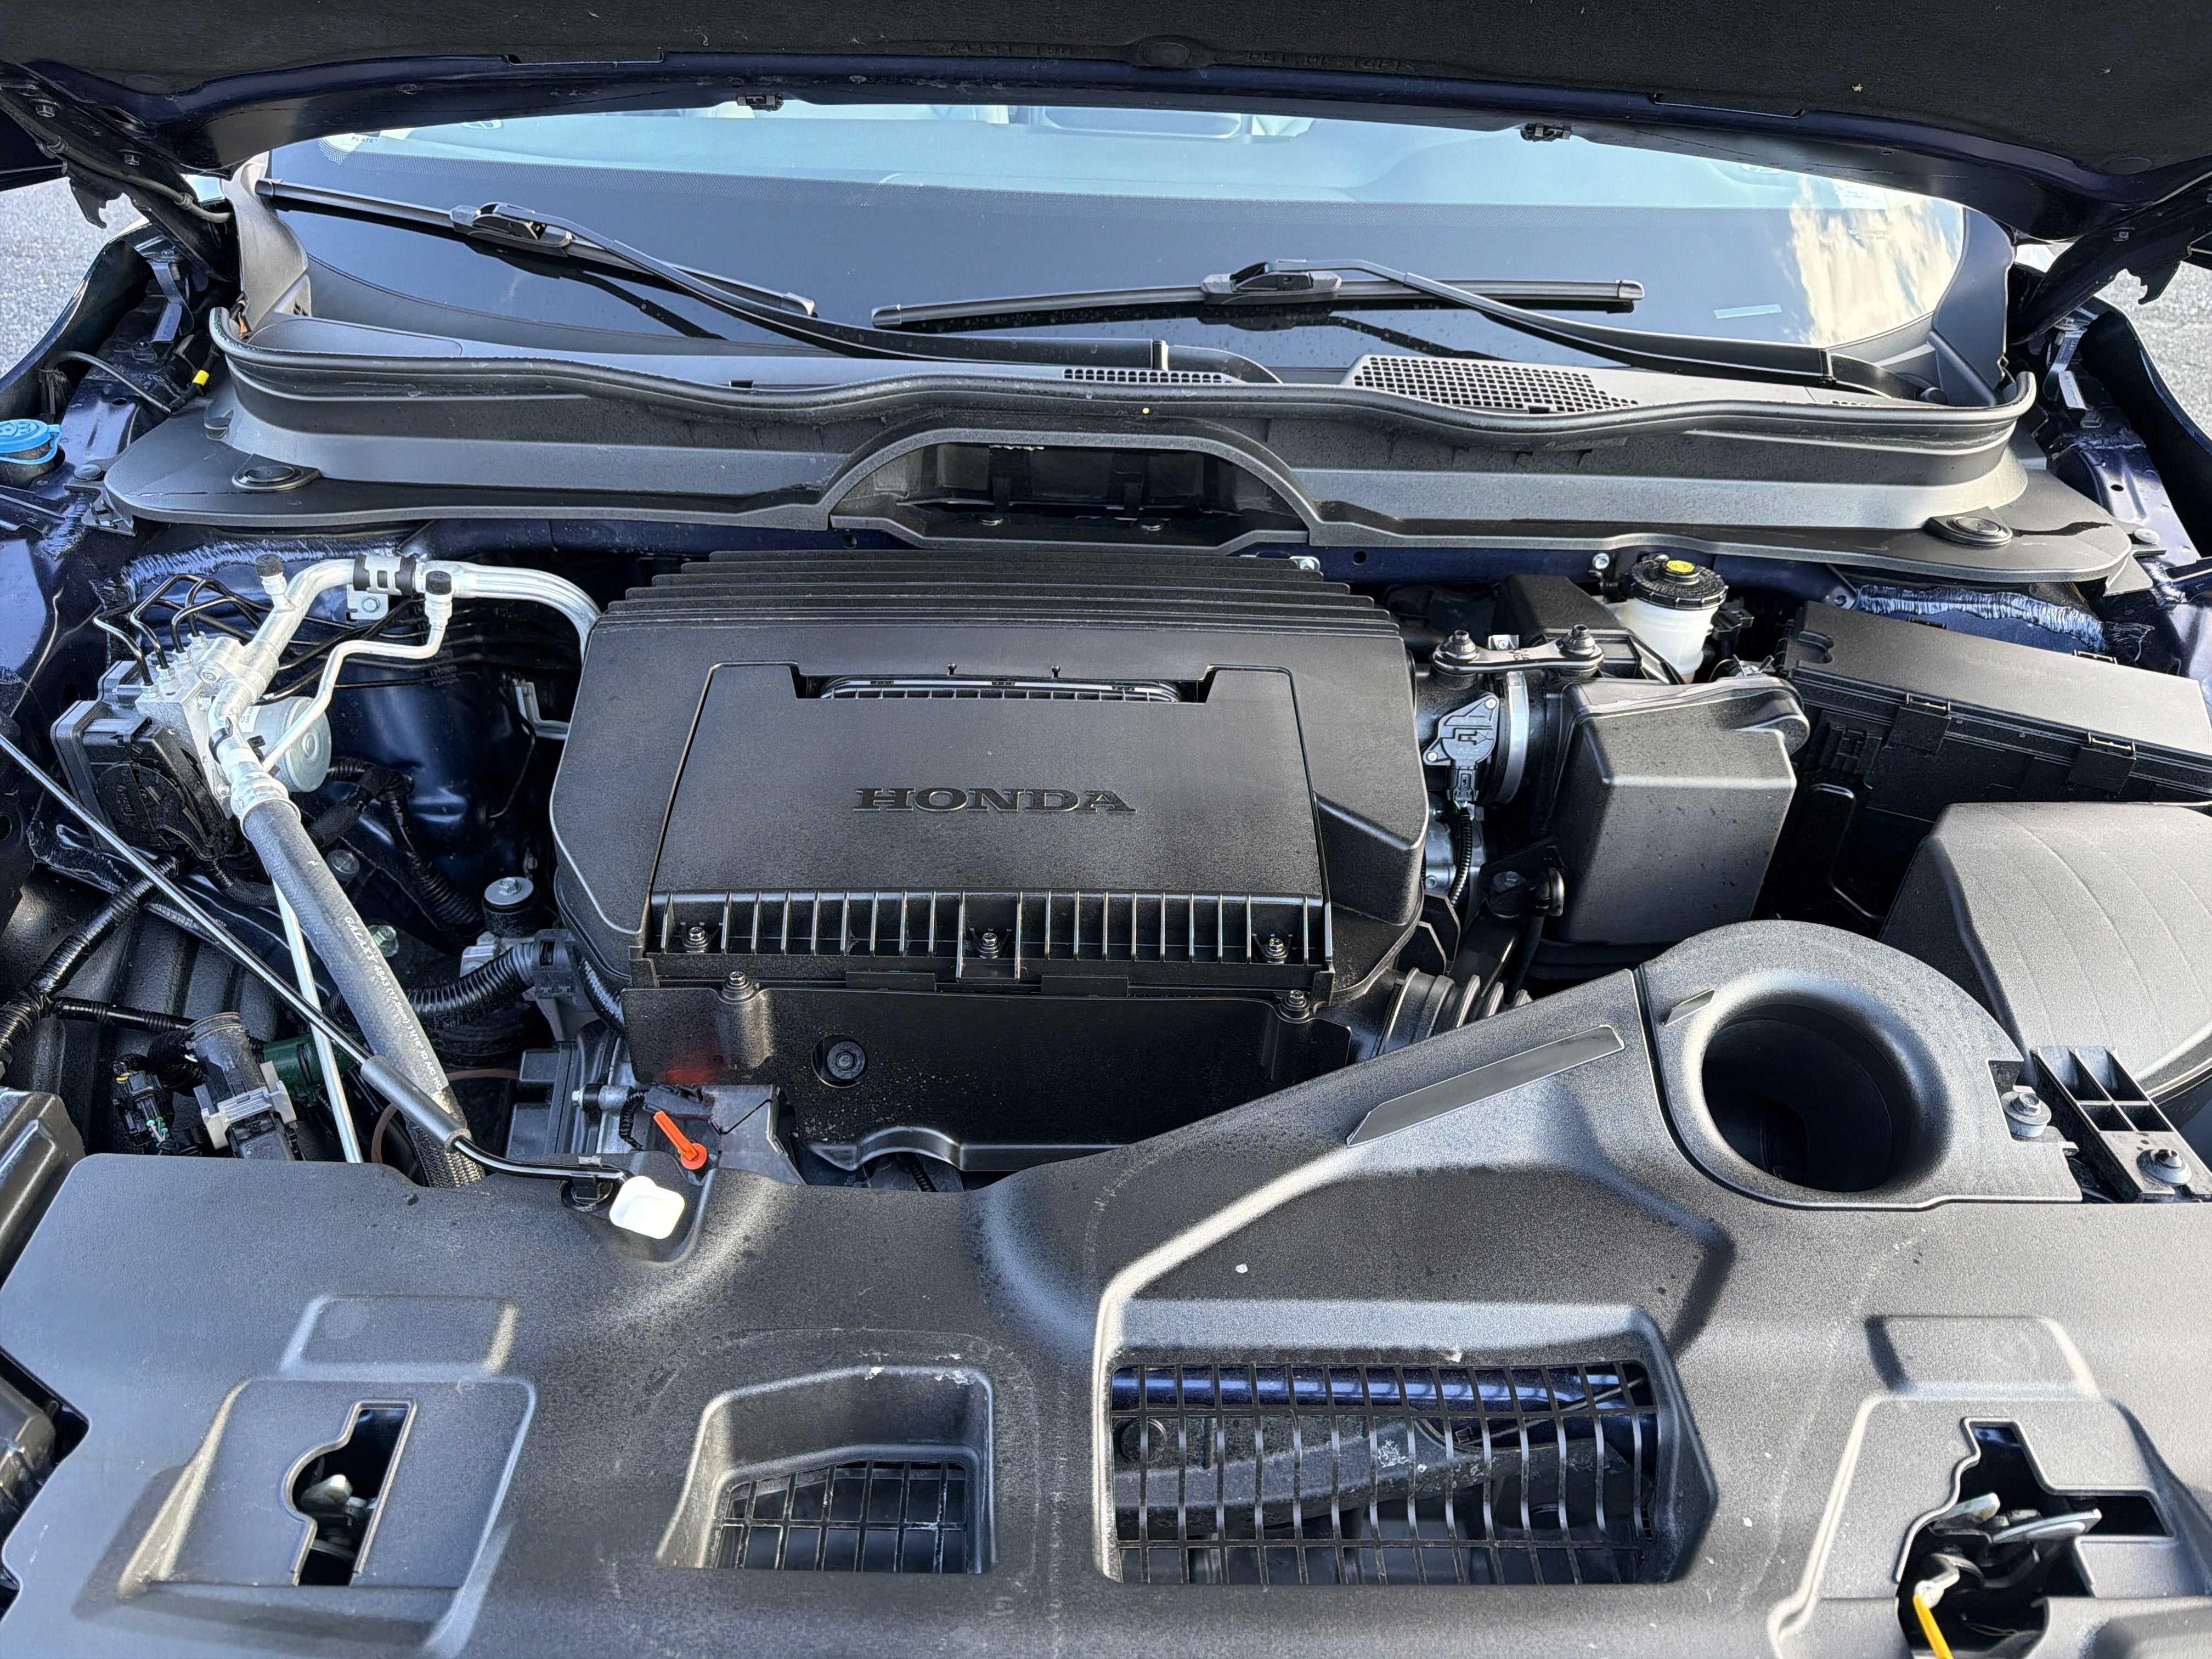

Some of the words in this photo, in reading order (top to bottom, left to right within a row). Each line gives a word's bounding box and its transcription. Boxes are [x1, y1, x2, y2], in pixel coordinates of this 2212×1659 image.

[853, 787, 1137, 814] HONDA
[344, 916, 378, 962] GALAXY
[374, 964, 391, 987] 4843
[386, 987, 411, 1024] (17.5mm)
[407, 1024, 424, 1049] 11/16"
[419, 1049, 430, 1062] ID
[424, 1061, 436, 1076] A/C
